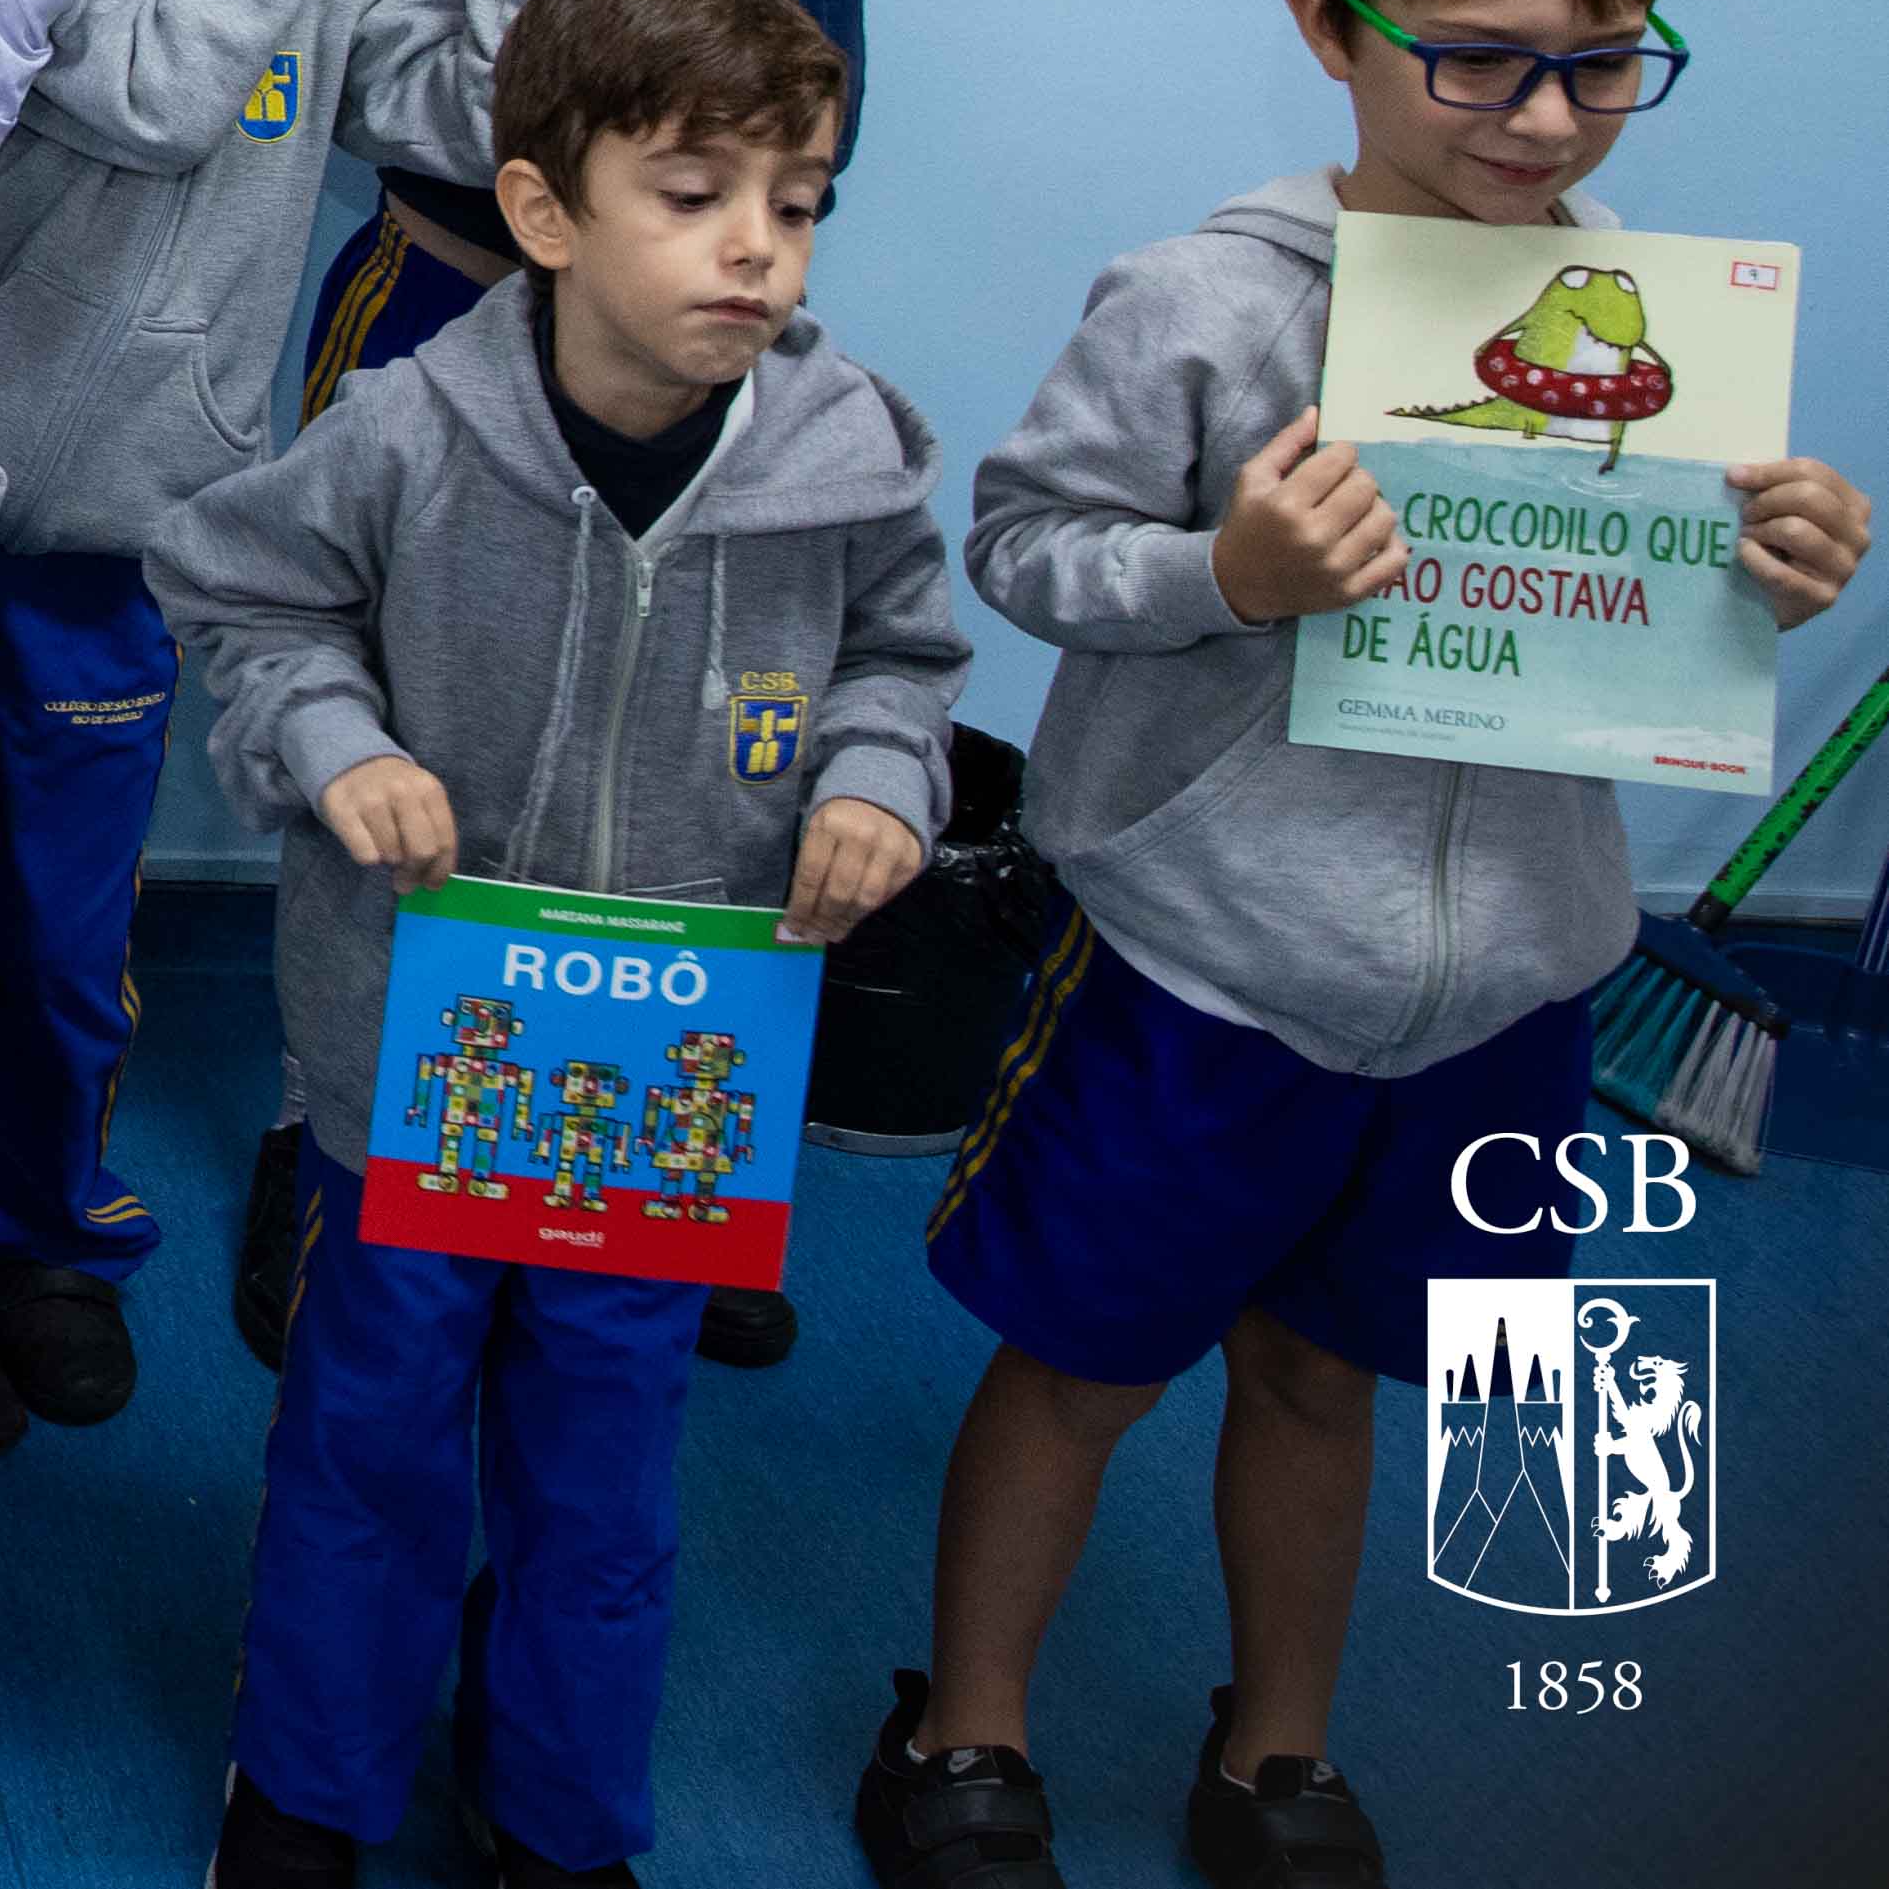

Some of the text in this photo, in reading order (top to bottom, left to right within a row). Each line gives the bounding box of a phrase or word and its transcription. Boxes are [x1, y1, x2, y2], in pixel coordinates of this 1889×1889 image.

[1404, 492, 1730, 569] CROCODILO QUE
[1460, 564, 1650, 626] GOSTAVA
[1343, 612, 1521, 676] DE ÁGUA
[741, 671, 800, 691] CSB
[1338, 698, 1506, 731] GEMMA MERINO
[502, 944, 709, 1006] ROBÔ
